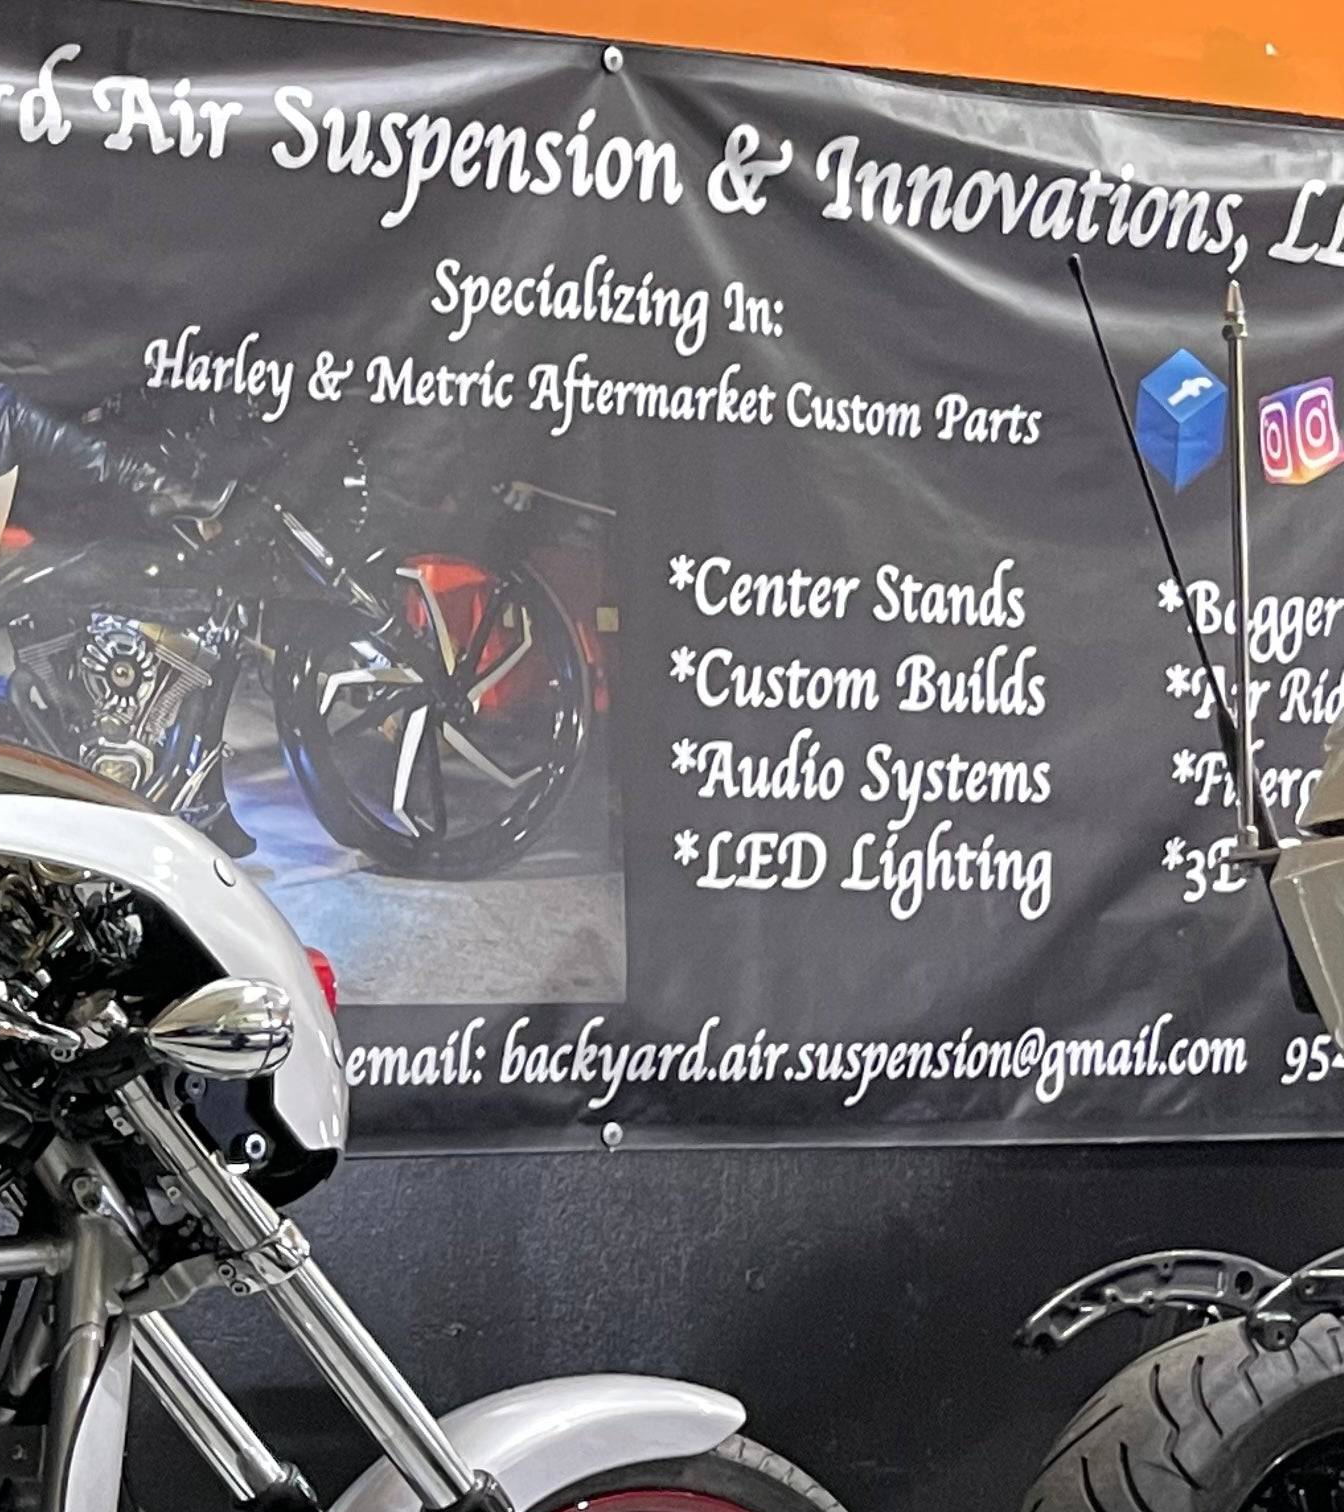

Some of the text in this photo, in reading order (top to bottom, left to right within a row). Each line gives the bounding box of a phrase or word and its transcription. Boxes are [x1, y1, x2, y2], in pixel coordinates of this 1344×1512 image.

[92, 75, 243, 158] Air
[271, 85, 683, 229] Suspension
[707, 123, 793, 215] &
[815, 135, 1248, 274] Innovations,
[430, 254, 783, 356] Specializing In:
[144, 325, 1042, 445] Harley & Metric Aftermarket Custom Parts
[873, 558, 1025, 629] Stands
[896, 644, 1047, 717] Builds
[860, 742, 1051, 831] Systems
[841, 821, 1053, 920] Lighting
[345, 1016, 486, 1086] email:
[499, 1012, 1248, 1110] backyard.air.suspension@gmail.com
